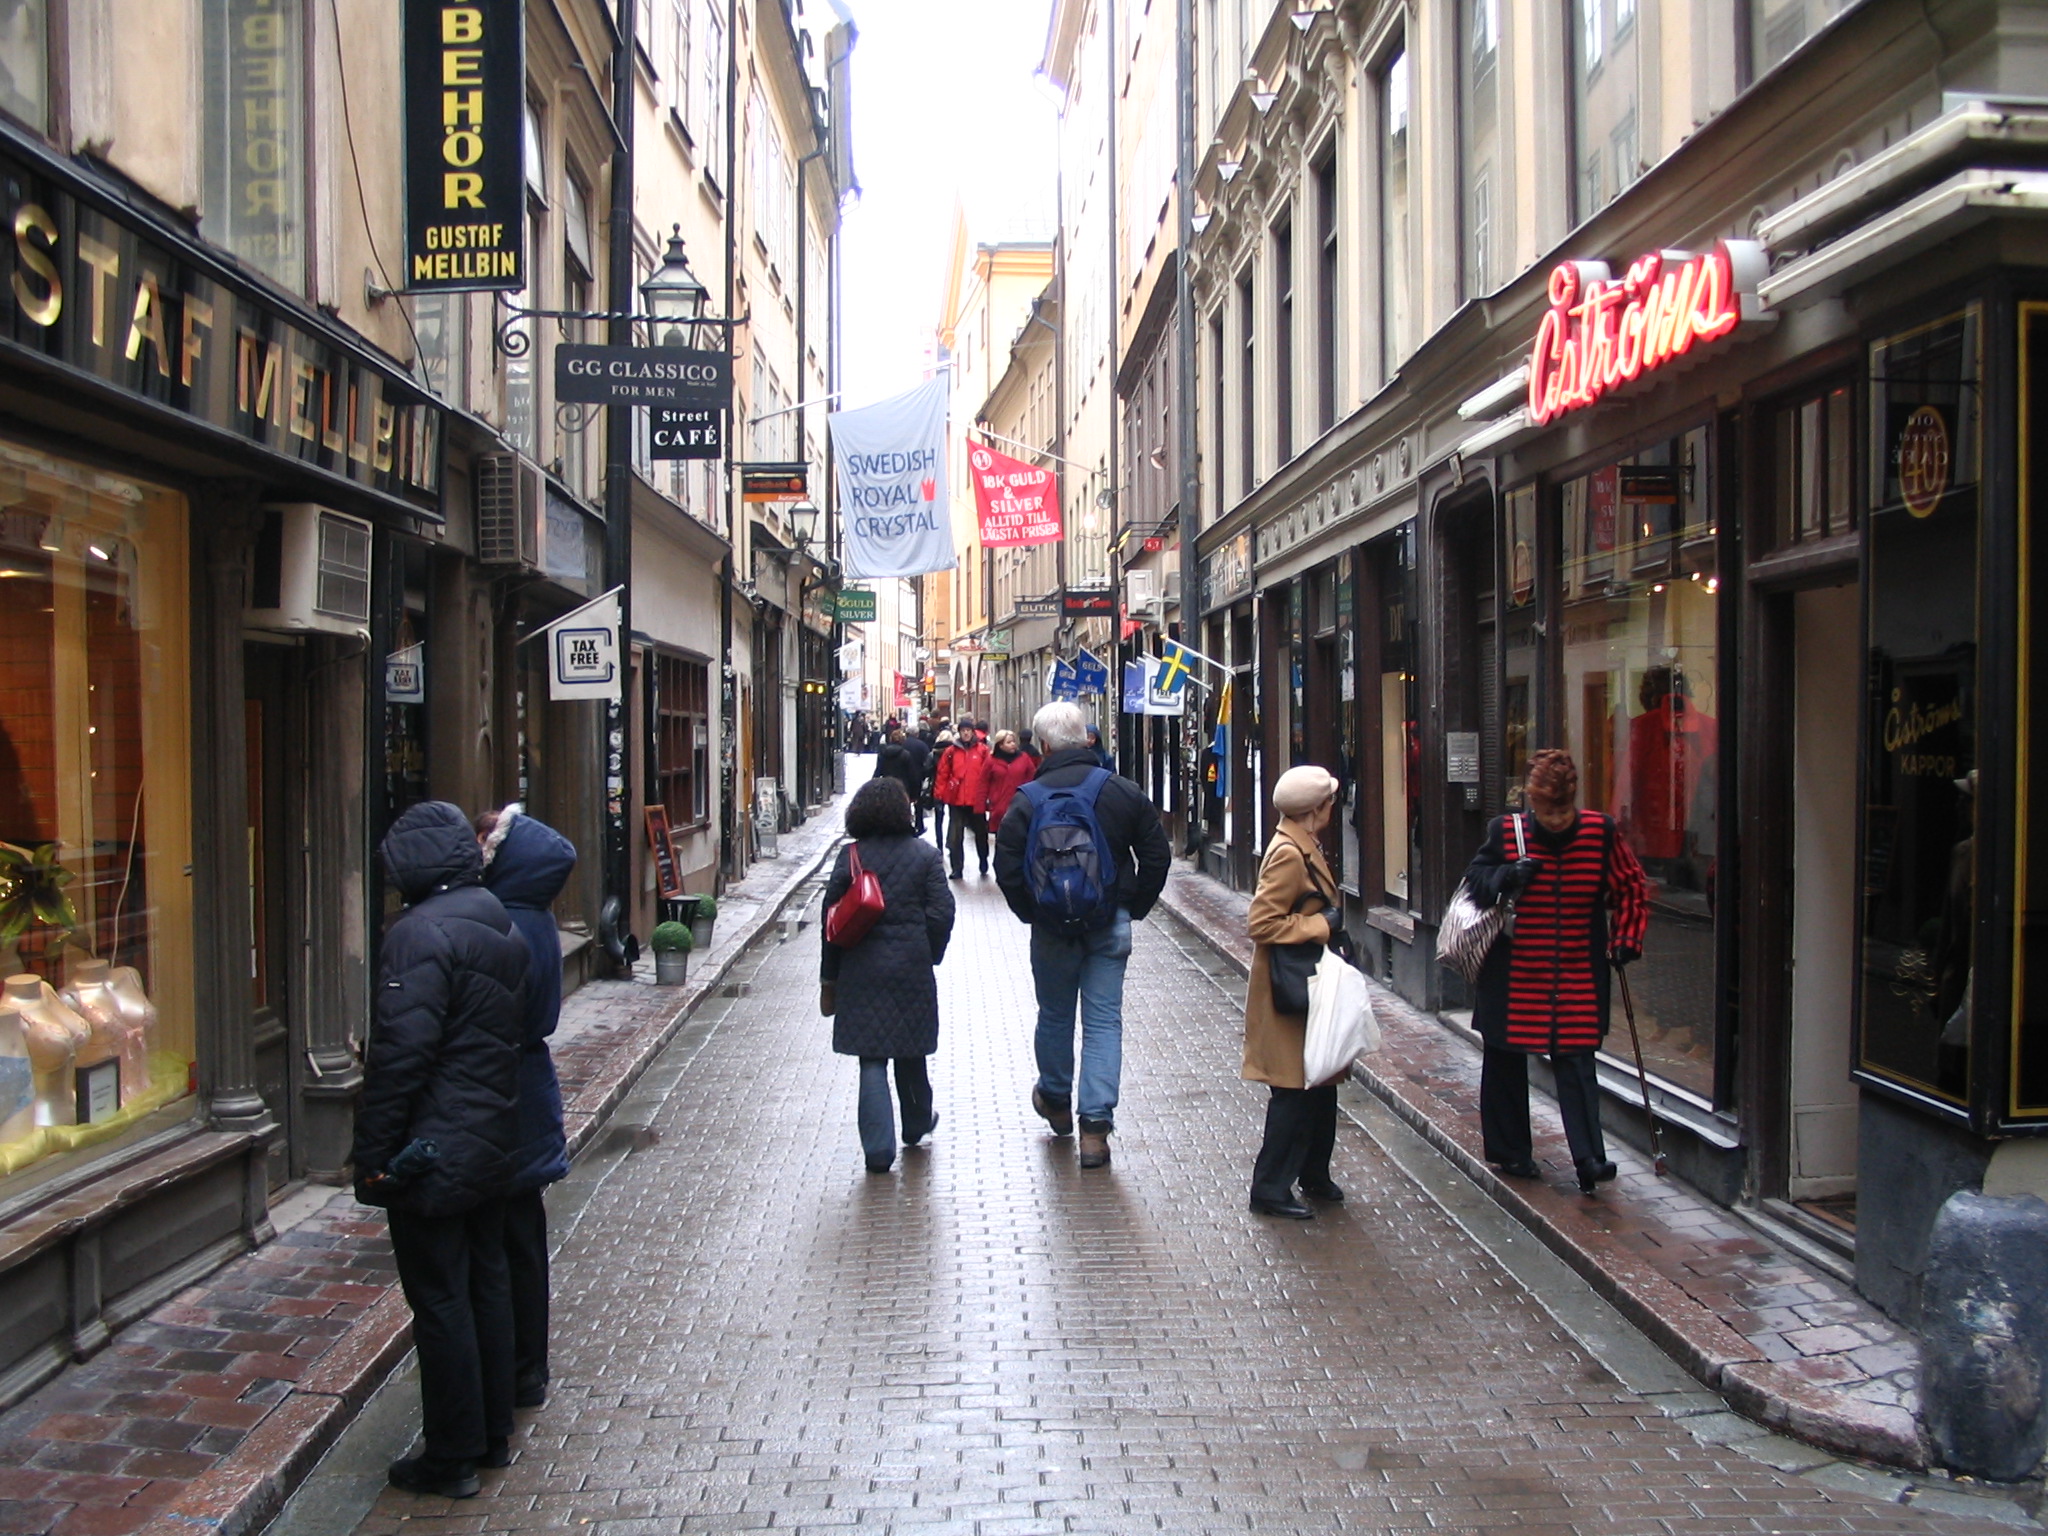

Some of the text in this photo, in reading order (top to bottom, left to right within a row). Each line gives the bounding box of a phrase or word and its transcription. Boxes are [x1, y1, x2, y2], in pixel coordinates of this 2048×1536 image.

[441, 0, 487, 209] BEHÖR
[426, 223, 503, 249] GUSTAF
[414, 251, 516, 280] MELLBIN
[10, 203, 214, 388] STAF
[567, 359, 718, 381] GG CLASSICO
[611, 385, 677, 398] FOR MEN
[662, 410, 709, 423] Street
[654, 425, 718, 446] CAFÉ
[848, 448, 935, 476] SWEDISH
[982, 470, 1046, 489] 18K GULD
[852, 483, 918, 508] ROYAL
[1003, 486, 1015, 500] &
[990, 496, 1044, 513] SILVER
[855, 509, 939, 537] CRYSTAL
[984, 511, 1051, 529] ALLTID TILL
[1022, 522, 1060, 539] PRISER
[846, 600, 874, 609] GULD
[1021, 604, 1057, 612] BUTIK
[840, 611, 874, 619] SILVER
[571, 640, 597, 653] TAX
[570, 652, 600, 665] FREE
